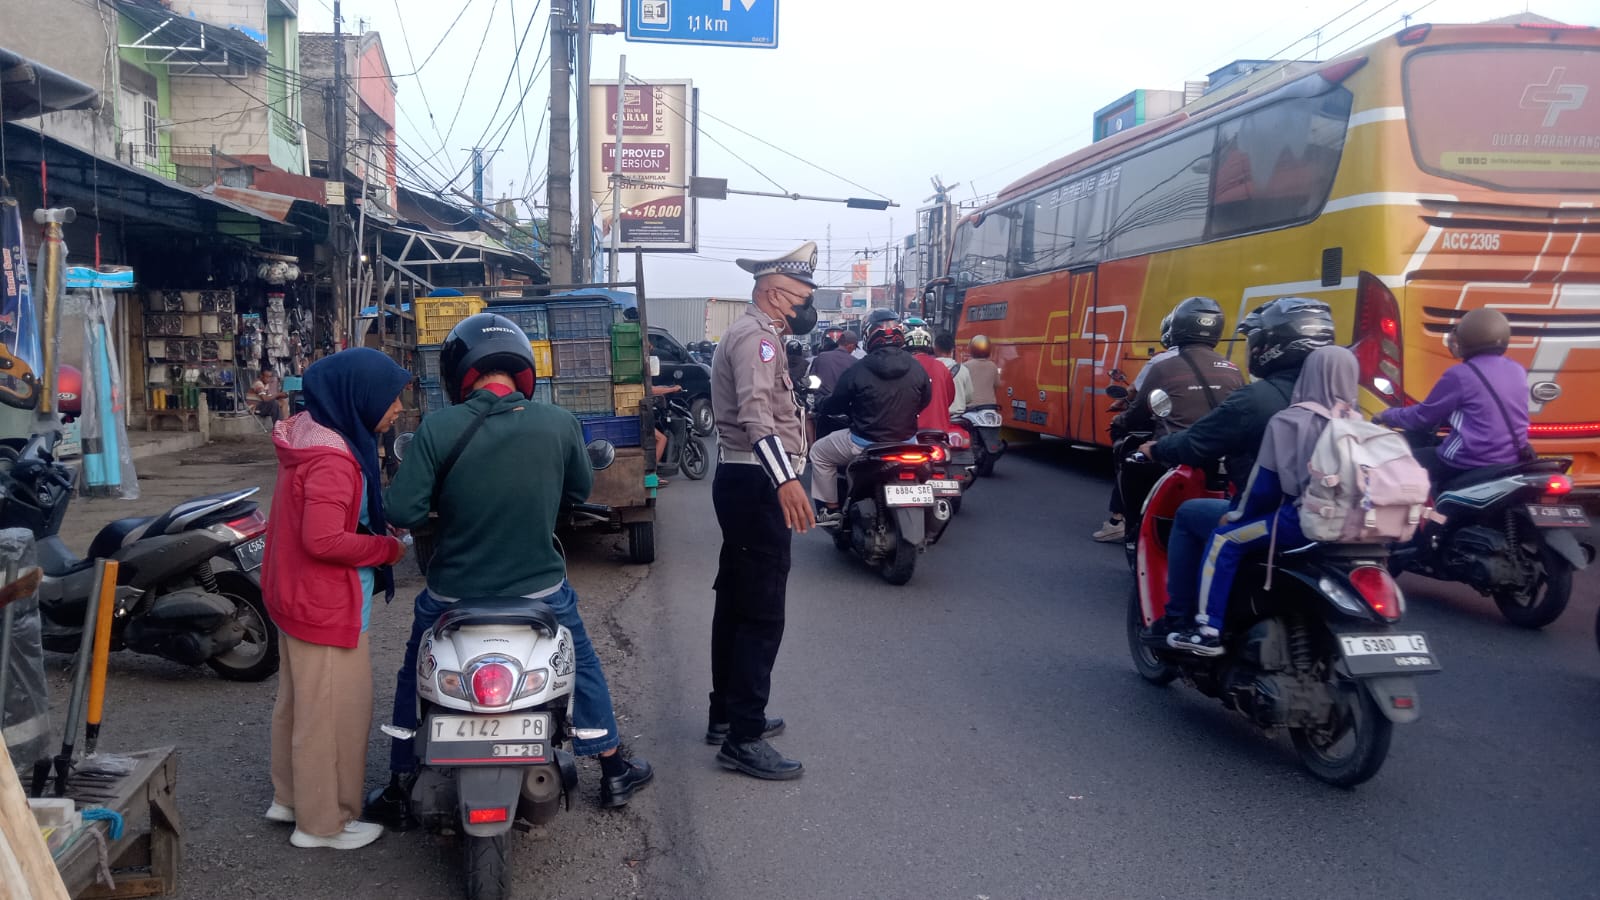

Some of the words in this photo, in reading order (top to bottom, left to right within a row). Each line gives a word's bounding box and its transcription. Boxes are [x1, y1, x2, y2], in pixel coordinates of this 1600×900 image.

[687, 15, 700, 32] 1,1
[705, 16, 728, 32] km
[656, 85, 664, 131] KRETEK
[609, 149, 665, 158] IPROVED
[621, 160, 660, 168] ERSION
[1442, 232, 1468, 249] ACC
[1469, 233, 1500, 250] 2305
[482, 326, 516, 334] HONDA
[238, 547, 245, 558] T
[1344, 640, 1355, 654] T
[1361, 638, 1397, 652] 6380
[434, 721, 444, 738] T
[455, 719, 501, 737] 4142
